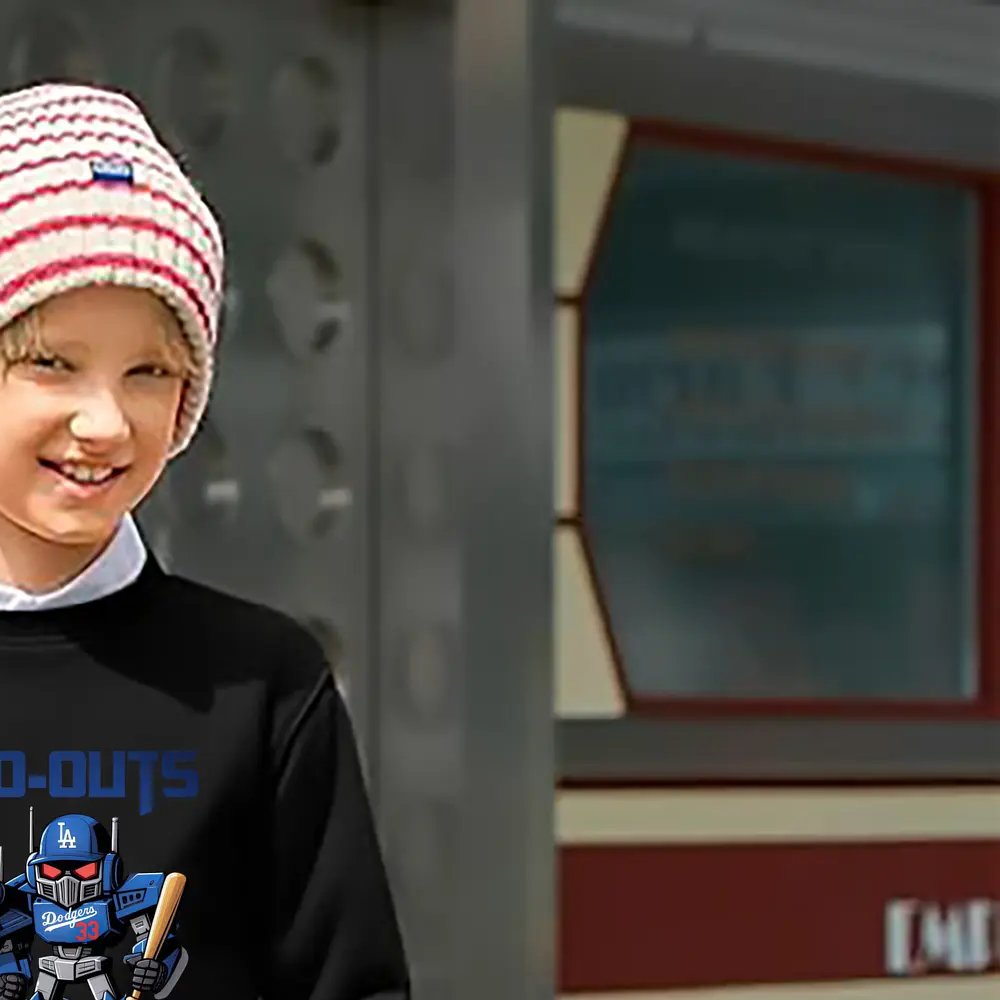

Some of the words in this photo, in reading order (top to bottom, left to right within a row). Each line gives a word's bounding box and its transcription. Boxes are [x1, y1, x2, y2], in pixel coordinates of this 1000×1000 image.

[57, 821, 77, 849] LA
[41, 905, 98, 932] Dodgers
[75, 920, 100, 941] 33
